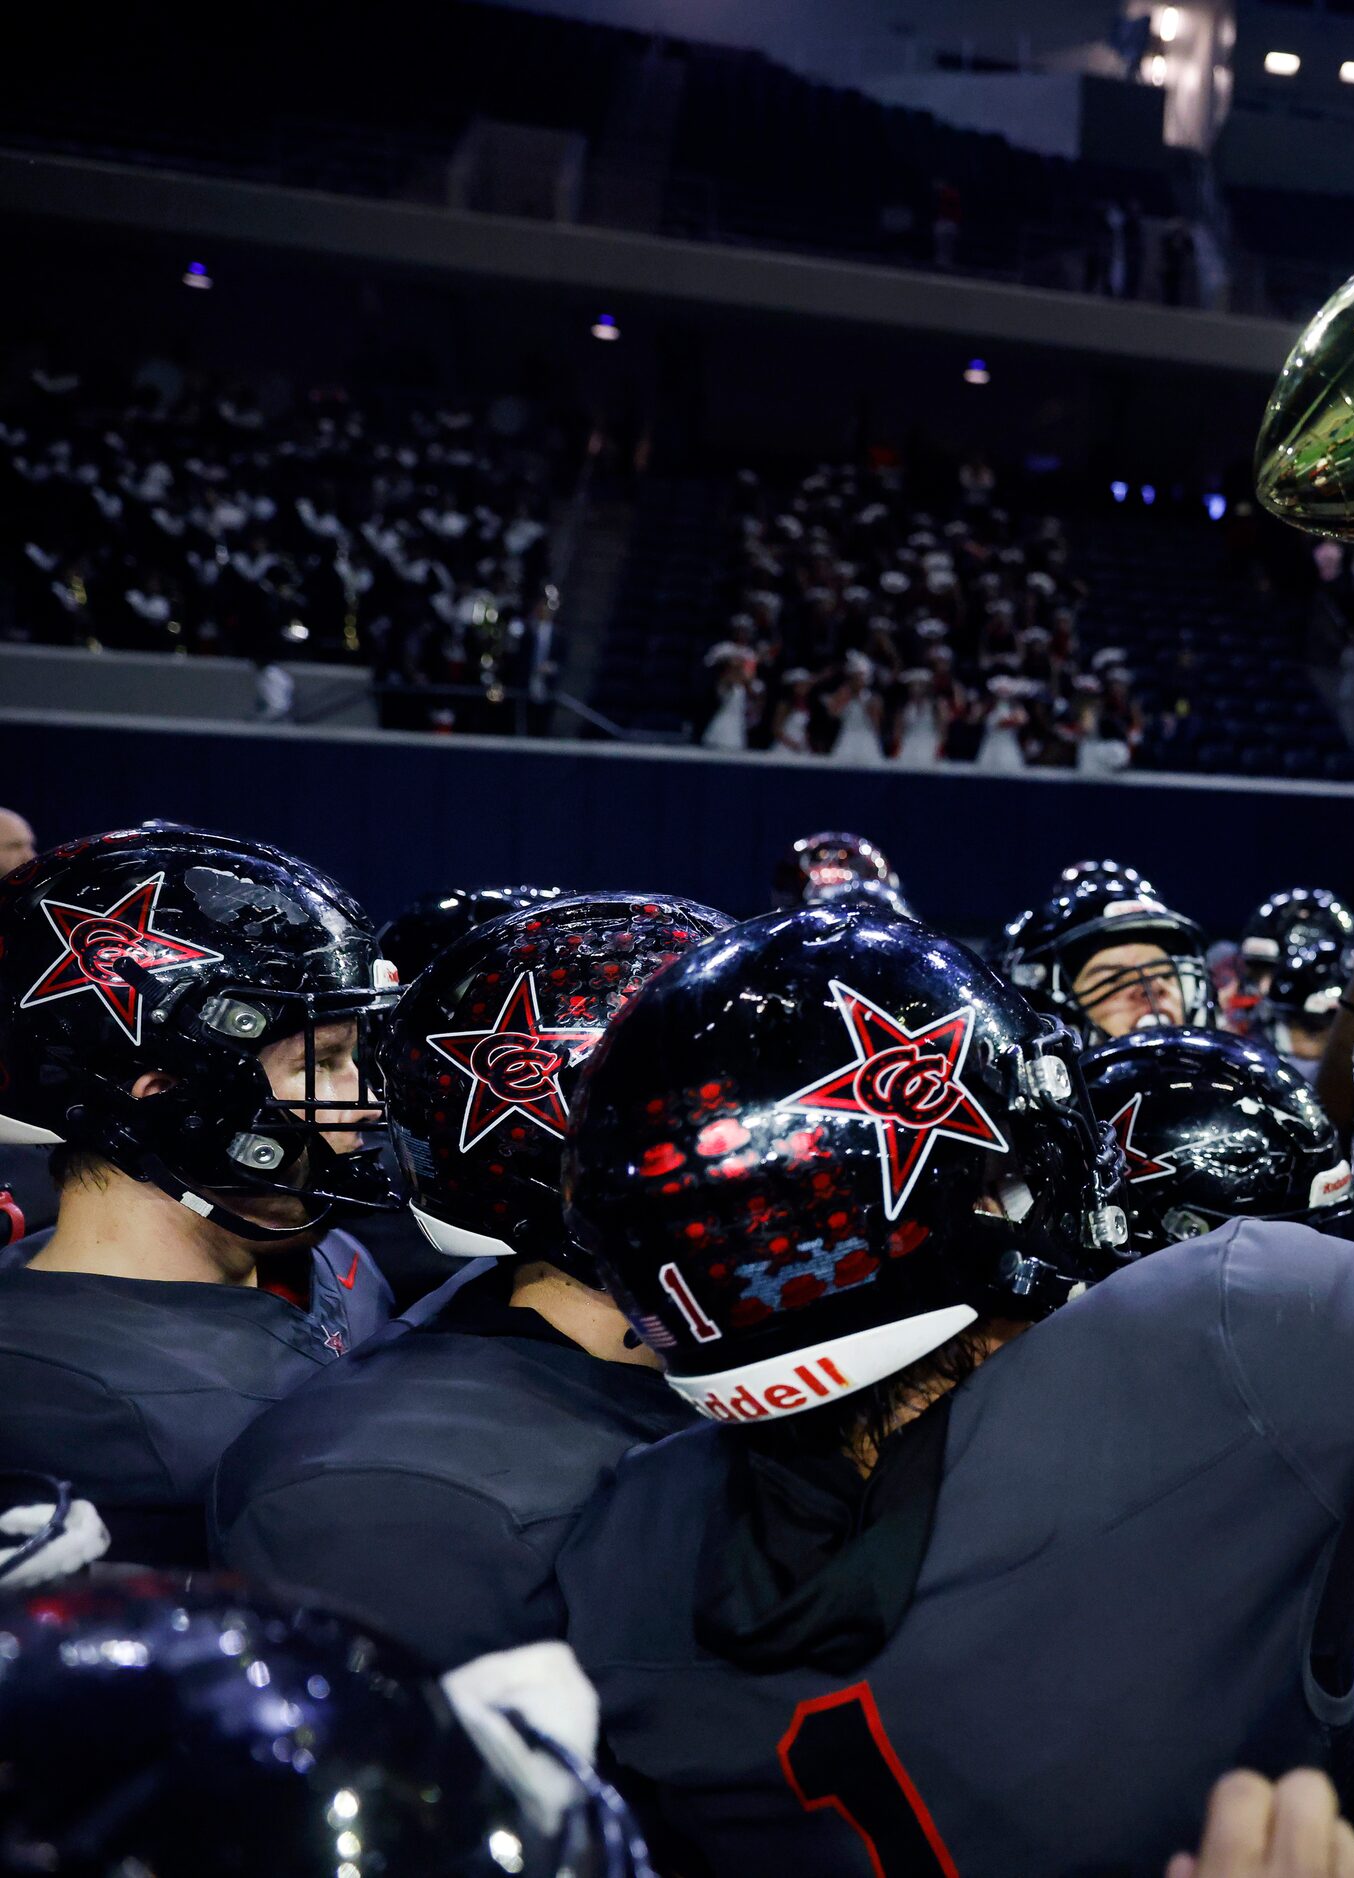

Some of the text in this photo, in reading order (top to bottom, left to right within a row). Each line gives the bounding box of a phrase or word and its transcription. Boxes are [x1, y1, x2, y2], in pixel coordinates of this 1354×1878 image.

[658, 1261, 723, 1344] 1
[705, 1357, 849, 1422] ddell
[775, 1680, 960, 1878] 1
